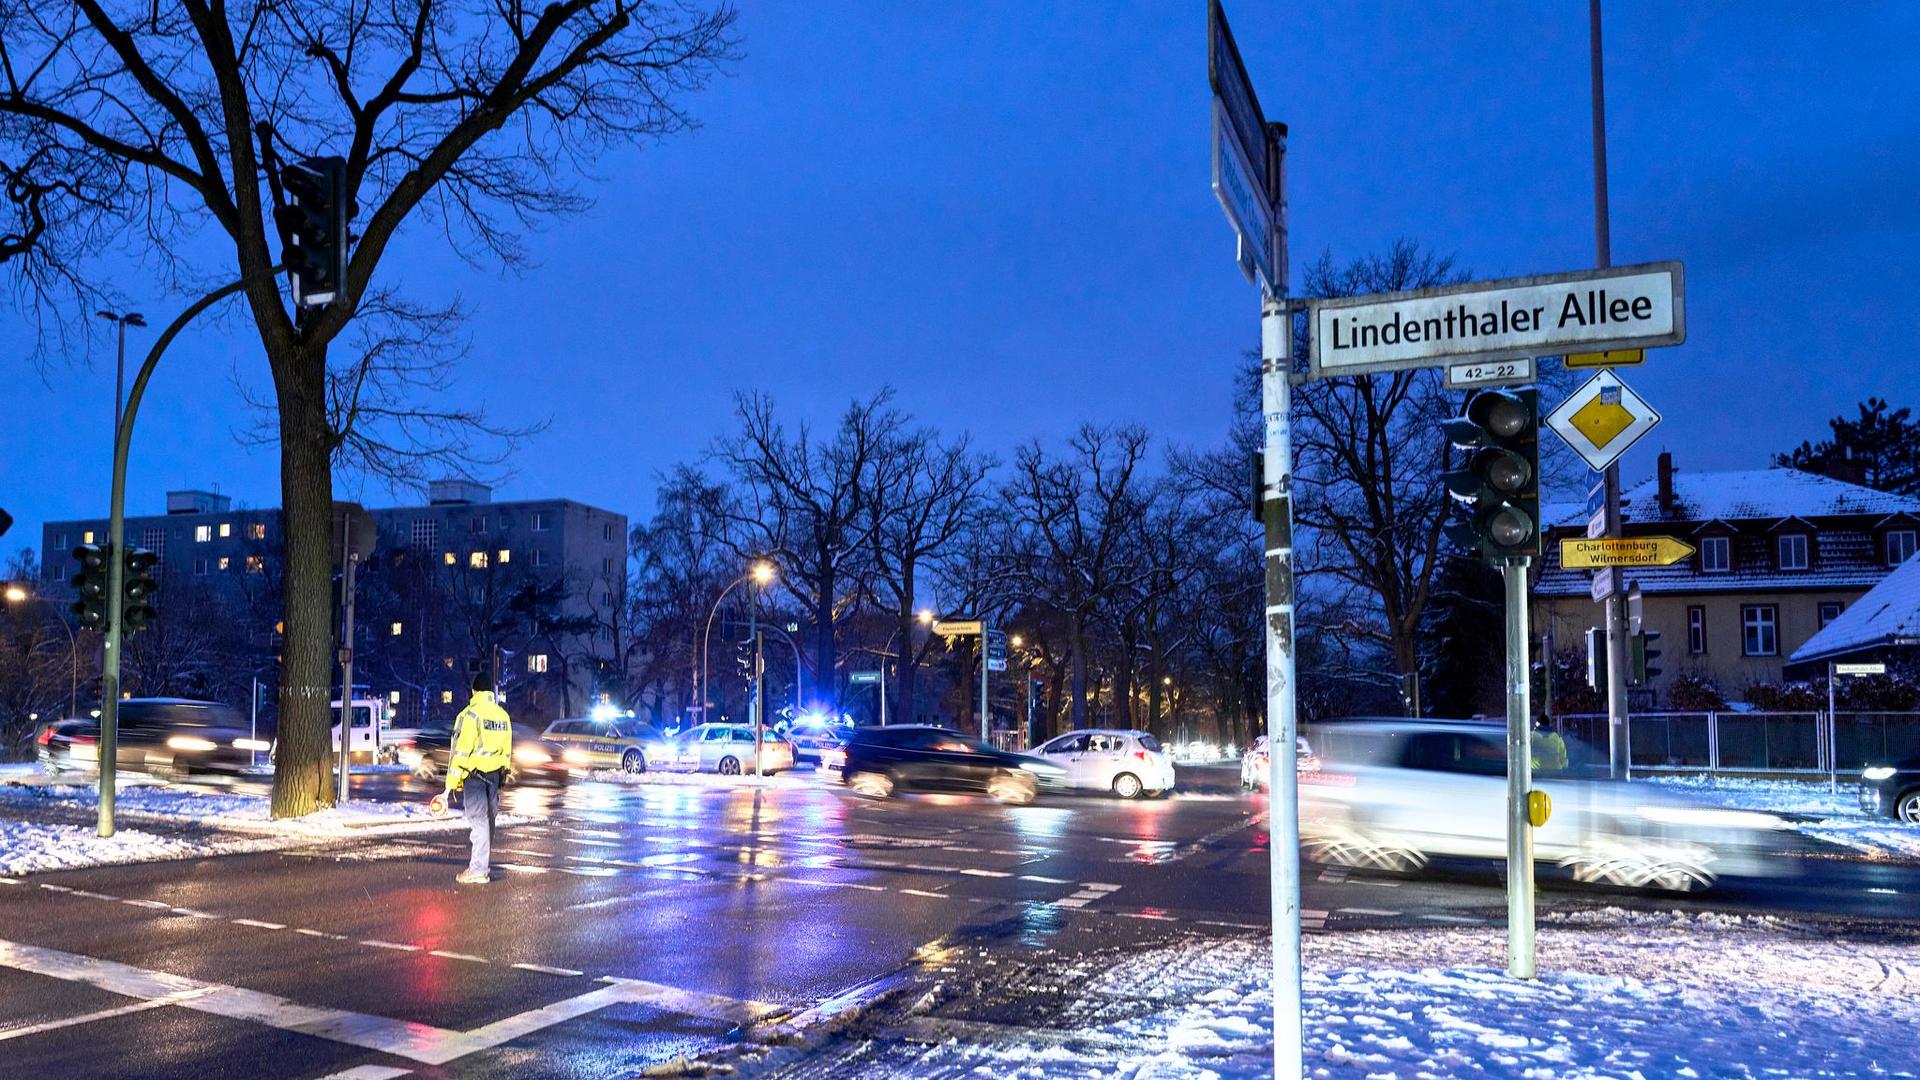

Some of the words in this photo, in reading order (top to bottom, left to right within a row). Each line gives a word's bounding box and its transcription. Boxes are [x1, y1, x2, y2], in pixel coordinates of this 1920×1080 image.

[1332, 300, 1545, 350] Lindenthaler
[1557, 289, 1653, 329] Allee
[1576, 541, 1658, 552] Charlottenburg
[1590, 553, 1657, 563] Wilmersdorf
